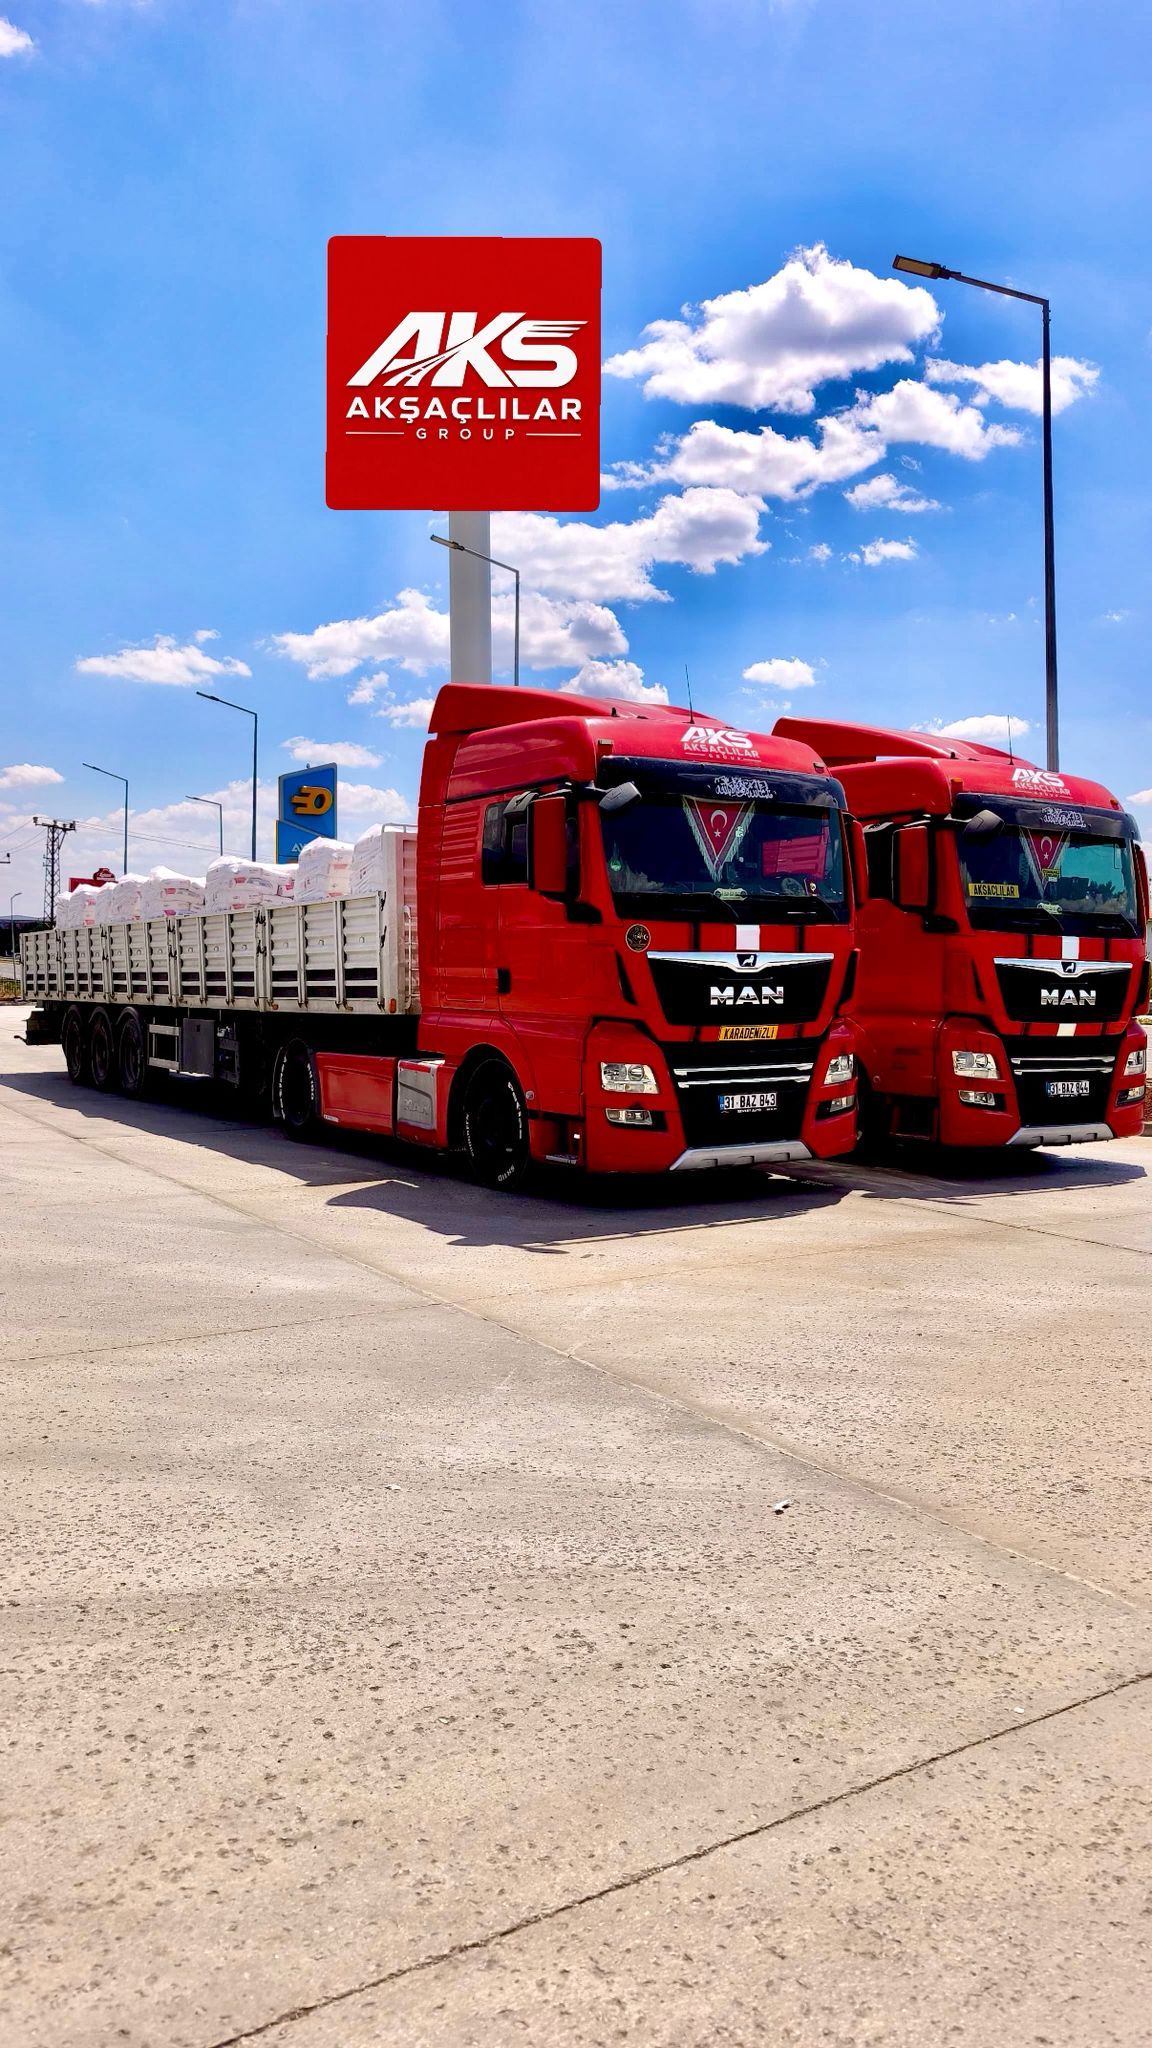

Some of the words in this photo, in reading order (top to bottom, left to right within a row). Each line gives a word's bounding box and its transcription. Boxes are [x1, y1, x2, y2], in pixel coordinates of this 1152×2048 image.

[346, 311, 589, 388] AKS
[345, 396, 582, 424] AKŞAÇLILAR
[415, 427, 515, 441] GROUP
[680, 726, 753, 749] AKS
[1011, 768, 1065, 788] AKS
[710, 986, 784, 1006] MAN
[1040, 989, 1097, 1006] MAN
[1050, 1082, 1059, 1095] 31
[1061, 1082, 1075, 1094] BAZ
[725, 1096, 735, 1109] 31
[739, 1094, 757, 1108] BAZ
[759, 1093, 776, 1107] 843
